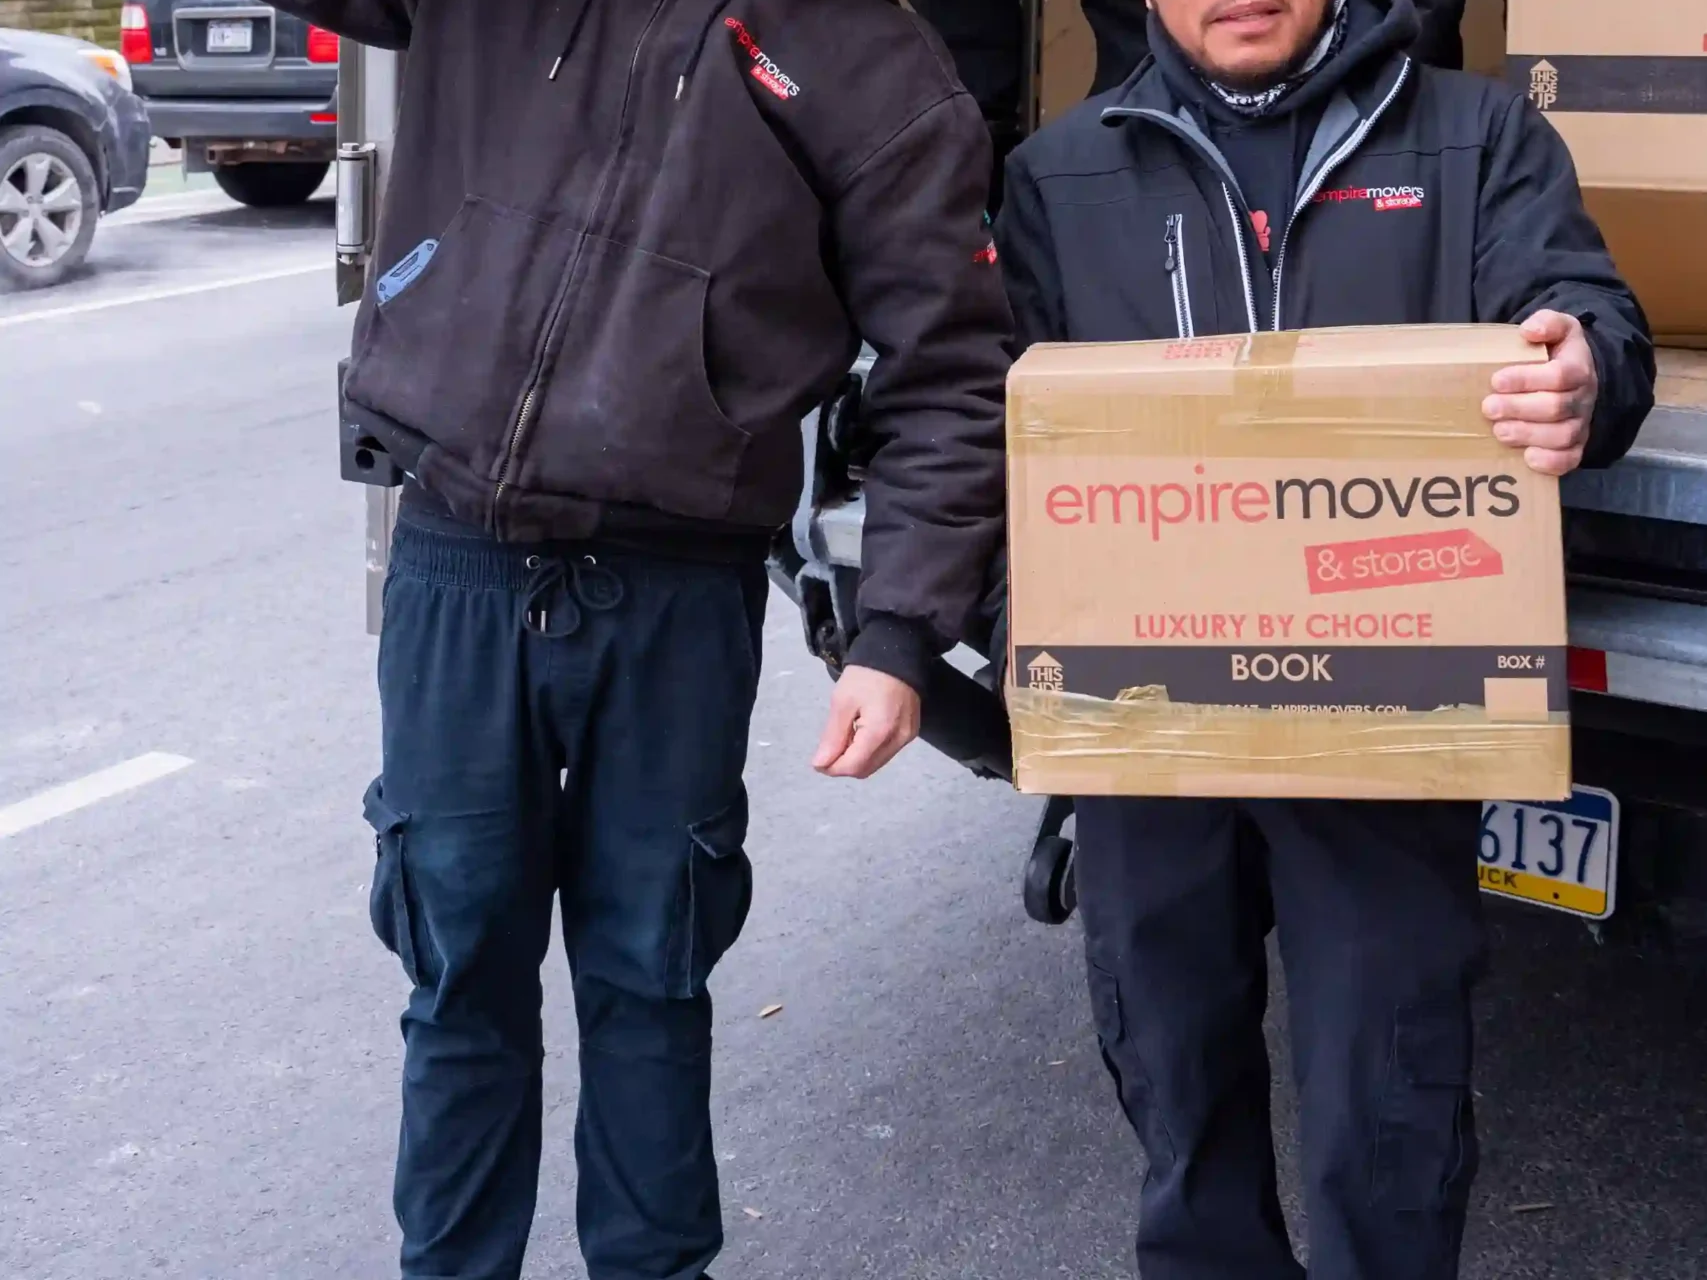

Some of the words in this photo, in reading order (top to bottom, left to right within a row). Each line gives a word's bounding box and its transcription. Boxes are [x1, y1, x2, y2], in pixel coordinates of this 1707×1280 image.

[1530, 70, 1558, 83] THIS
[1530, 81, 1558, 95] SIDE
[1045, 464, 1521, 542] empiremovers
[1316, 550, 1346, 582] &
[1353, 541, 1482, 581] storage
[1134, 613, 1247, 639] LUXURY
[1258, 613, 1295, 639] BY
[1305, 613, 1433, 639] CHOICE
[1231, 653, 1334, 683] BOOK
[1497, 654, 1532, 669] BOX
[1534, 655, 1546, 669] #
[1029, 667, 1063, 682] THIS
[1271, 704, 1409, 716] EMPIREMOVERSCOM
[1478, 804, 1598, 885] 6137
